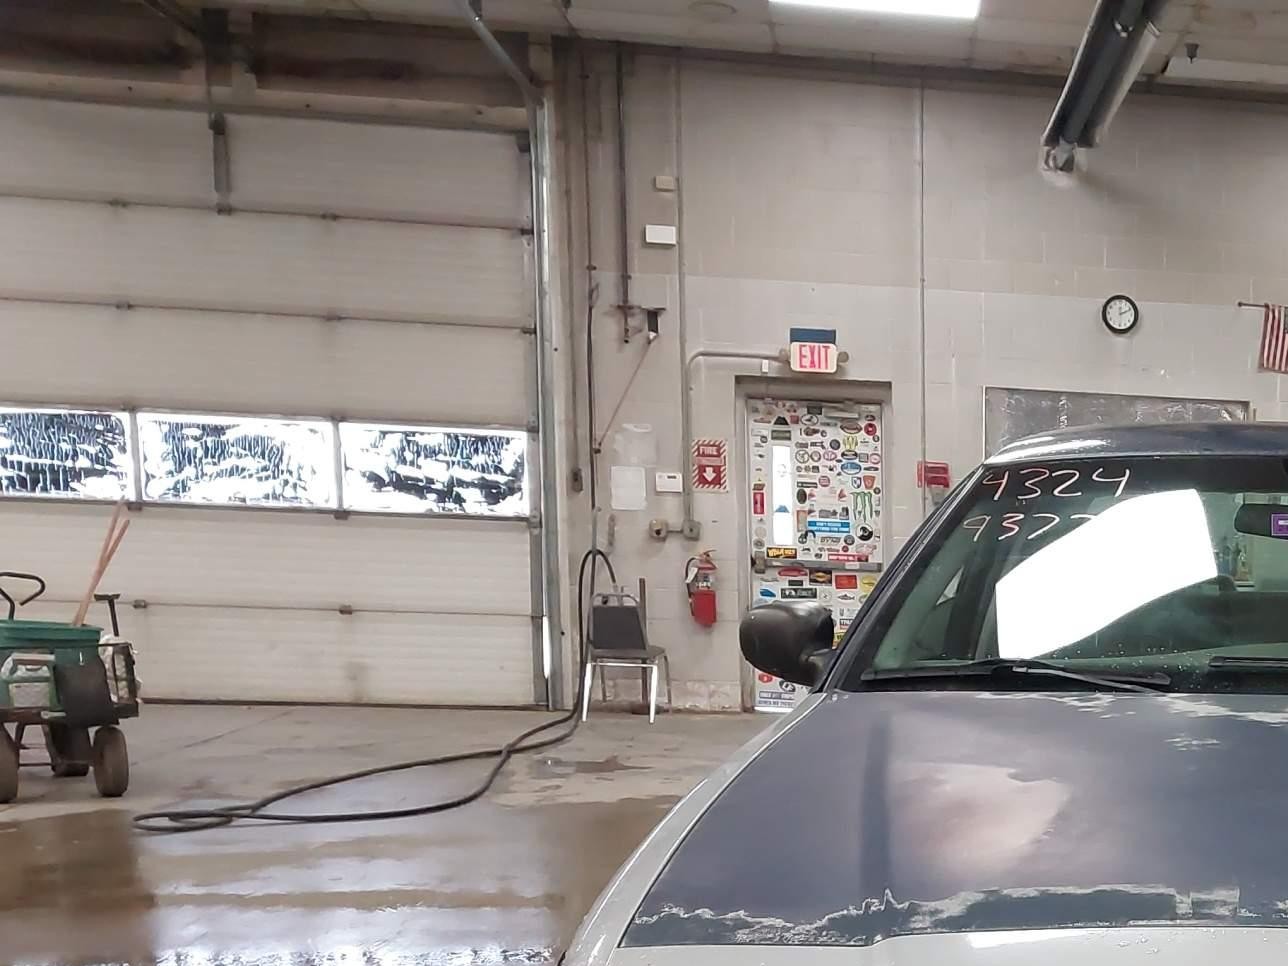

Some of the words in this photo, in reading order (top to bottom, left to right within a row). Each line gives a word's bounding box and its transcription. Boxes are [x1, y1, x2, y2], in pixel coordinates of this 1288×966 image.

[799, 344, 830, 370] EXIT
[700, 446, 718, 455] FIRE
[982, 468, 1130, 501] 4324
[963, 513, 1098, 542] 937
